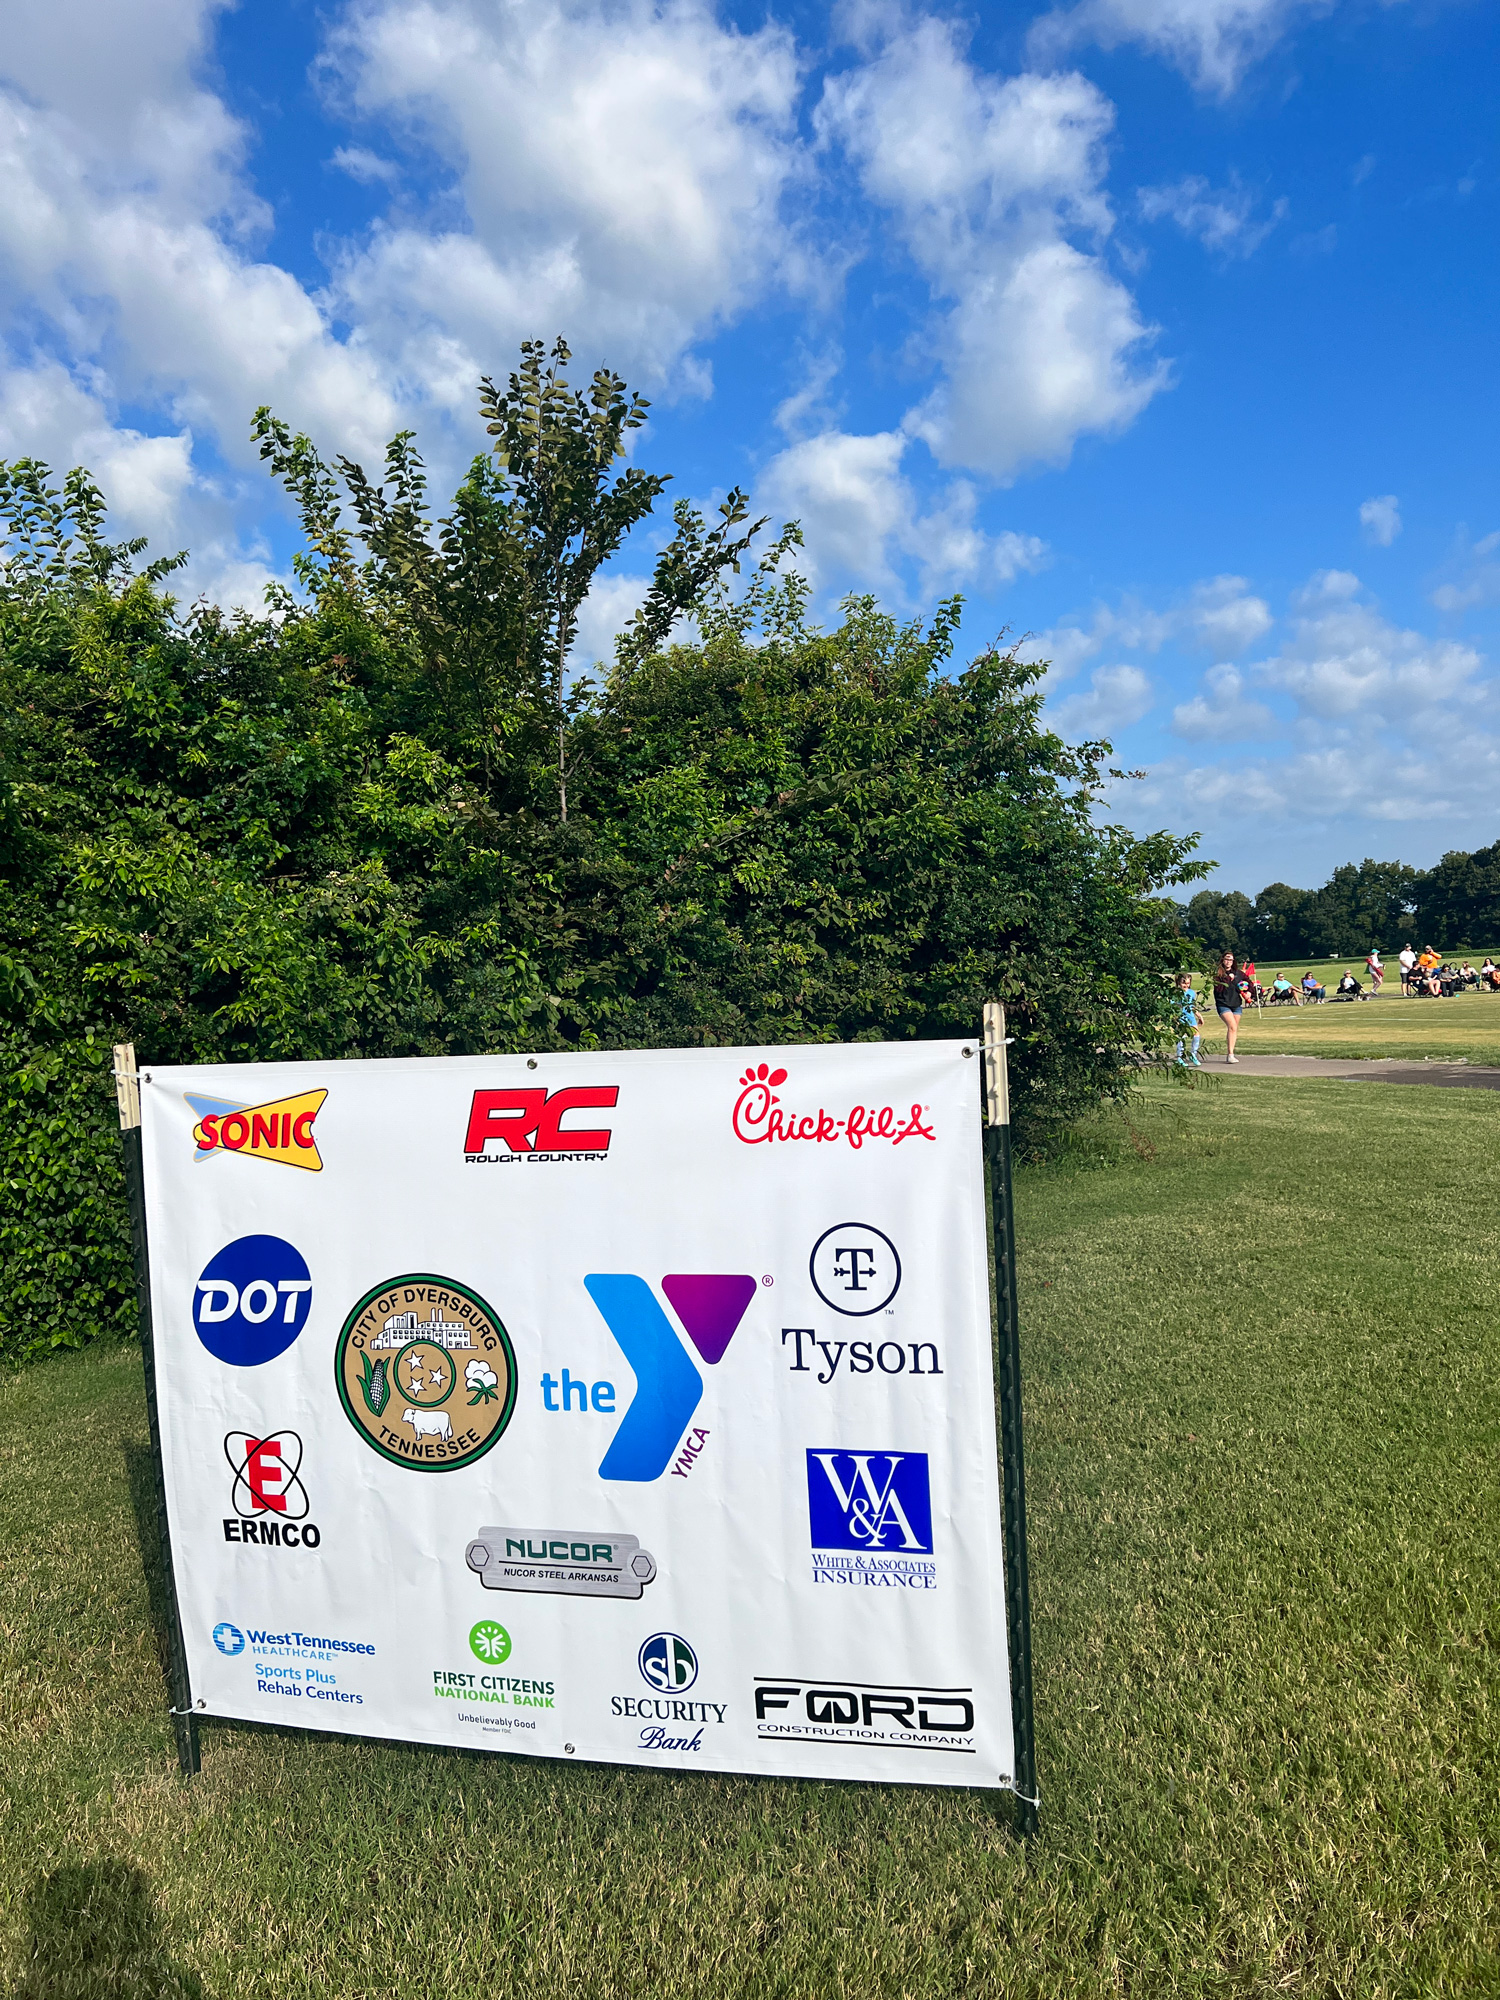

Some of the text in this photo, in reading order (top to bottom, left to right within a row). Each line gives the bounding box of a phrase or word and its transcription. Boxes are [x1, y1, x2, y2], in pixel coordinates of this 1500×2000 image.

[464, 1086, 619, 1153] RC
[732, 1083, 936, 1149] Chick-fil-A
[197, 1111, 316, 1151] SONIC
[465, 1153, 608, 1164] ROUGH COUNTRY
[197, 1279, 312, 1324] DOT
[352, 1288, 497, 1352] CITY OF DYERSBURG
[781, 1328, 943, 1384] Tyson
[540, 1368, 616, 1413] the
[379, 1425, 481, 1458] TENNESSEE
[671, 1428, 711, 1478] YMCA
[222, 1518, 321, 1549] ERMCO
[505, 1538, 613, 1563] NUCOR
[811, 1553, 936, 1573] WHITE & ASSOCIATES
[504, 1568, 619, 1583] NUCOR STEEL ARKANSAS
[813, 1570, 937, 1589] INSURANCE
[255, 1663, 336, 1684] Sports Plus
[433, 1671, 555, 1695] FIRST CITIZENS
[257, 1679, 363, 1704] Rehab Centers
[434, 1686, 555, 1709] NATIONAL BANK
[457, 1713, 536, 1730] Unbelievably Good
[611, 1696, 728, 1724] SECURITY
[755, 1686, 975, 1733] FORD
[637, 1726, 705, 1752] Bank
[757, 1724, 975, 1745] CONSTRUCTION COMPANY
